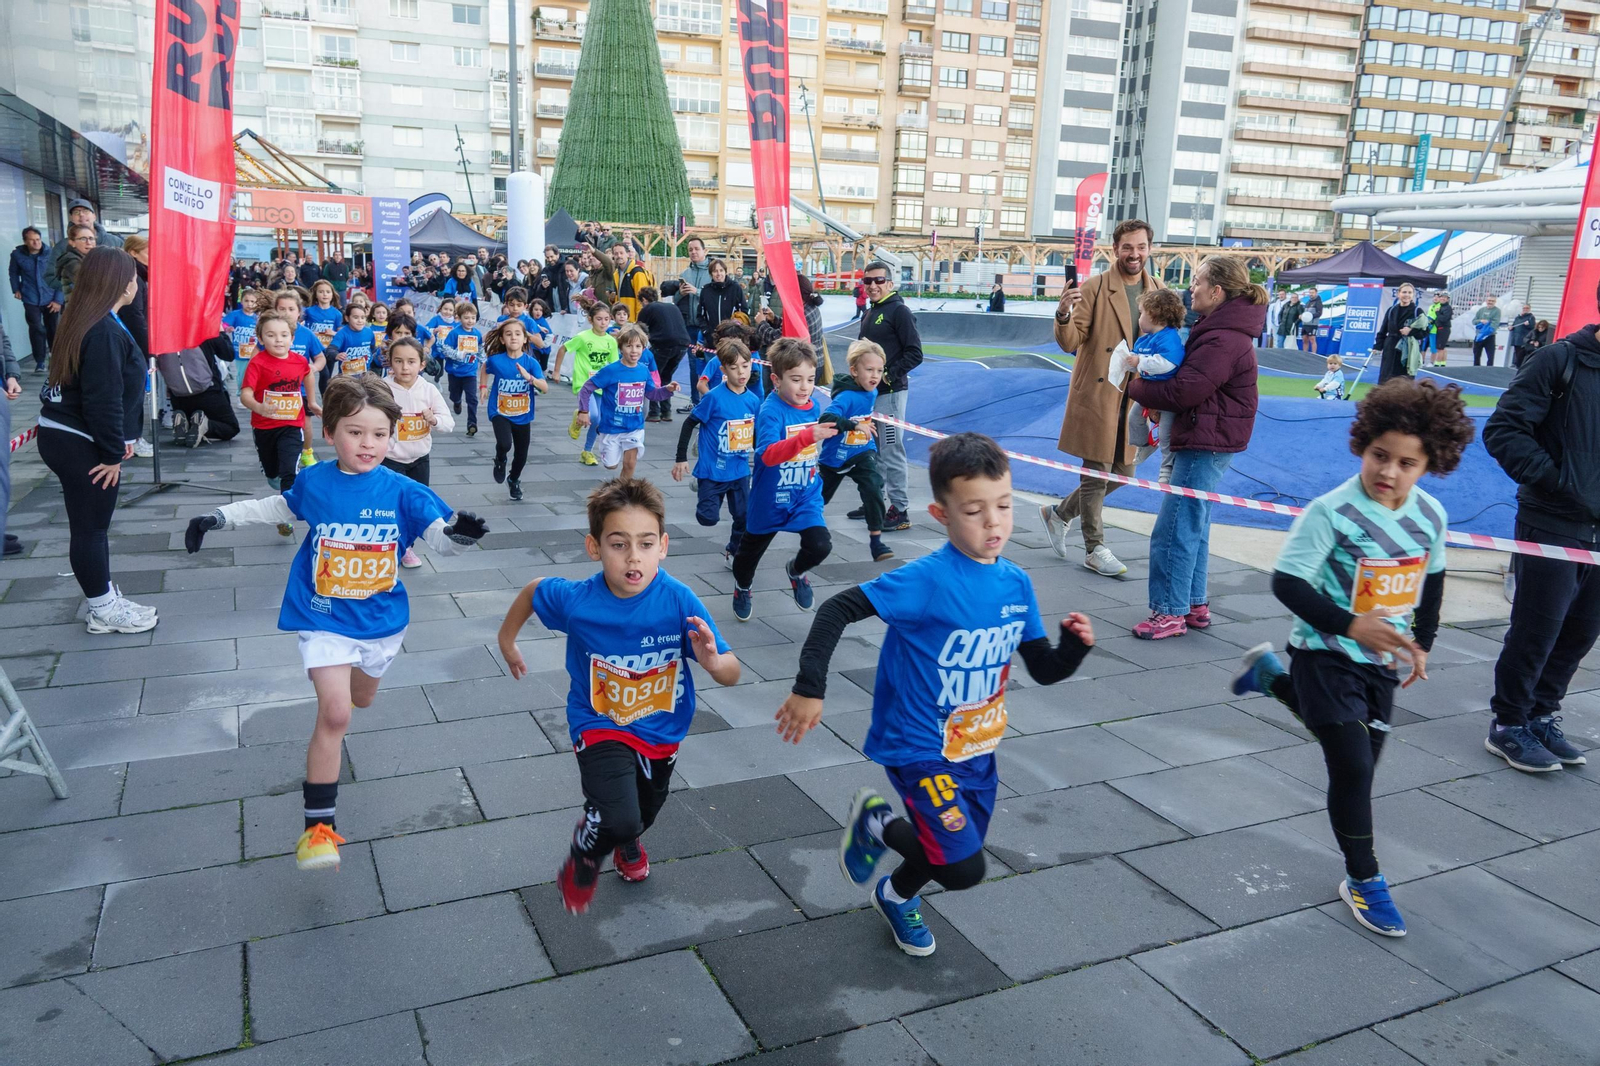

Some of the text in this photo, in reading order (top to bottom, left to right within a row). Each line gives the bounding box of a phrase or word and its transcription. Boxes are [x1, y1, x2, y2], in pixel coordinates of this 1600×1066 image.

[173, 191, 204, 210] DE VIGO
[306, 205, 343, 213] CONCELLO
[1348, 307, 1376, 318] ÉRGUETE
[1349, 321, 1371, 330] CORRE
[507, 399, 525, 408] 3011
[332, 556, 391, 579] 3032
[607, 675, 668, 707] 3030
[608, 704, 654, 724] Alcampo
